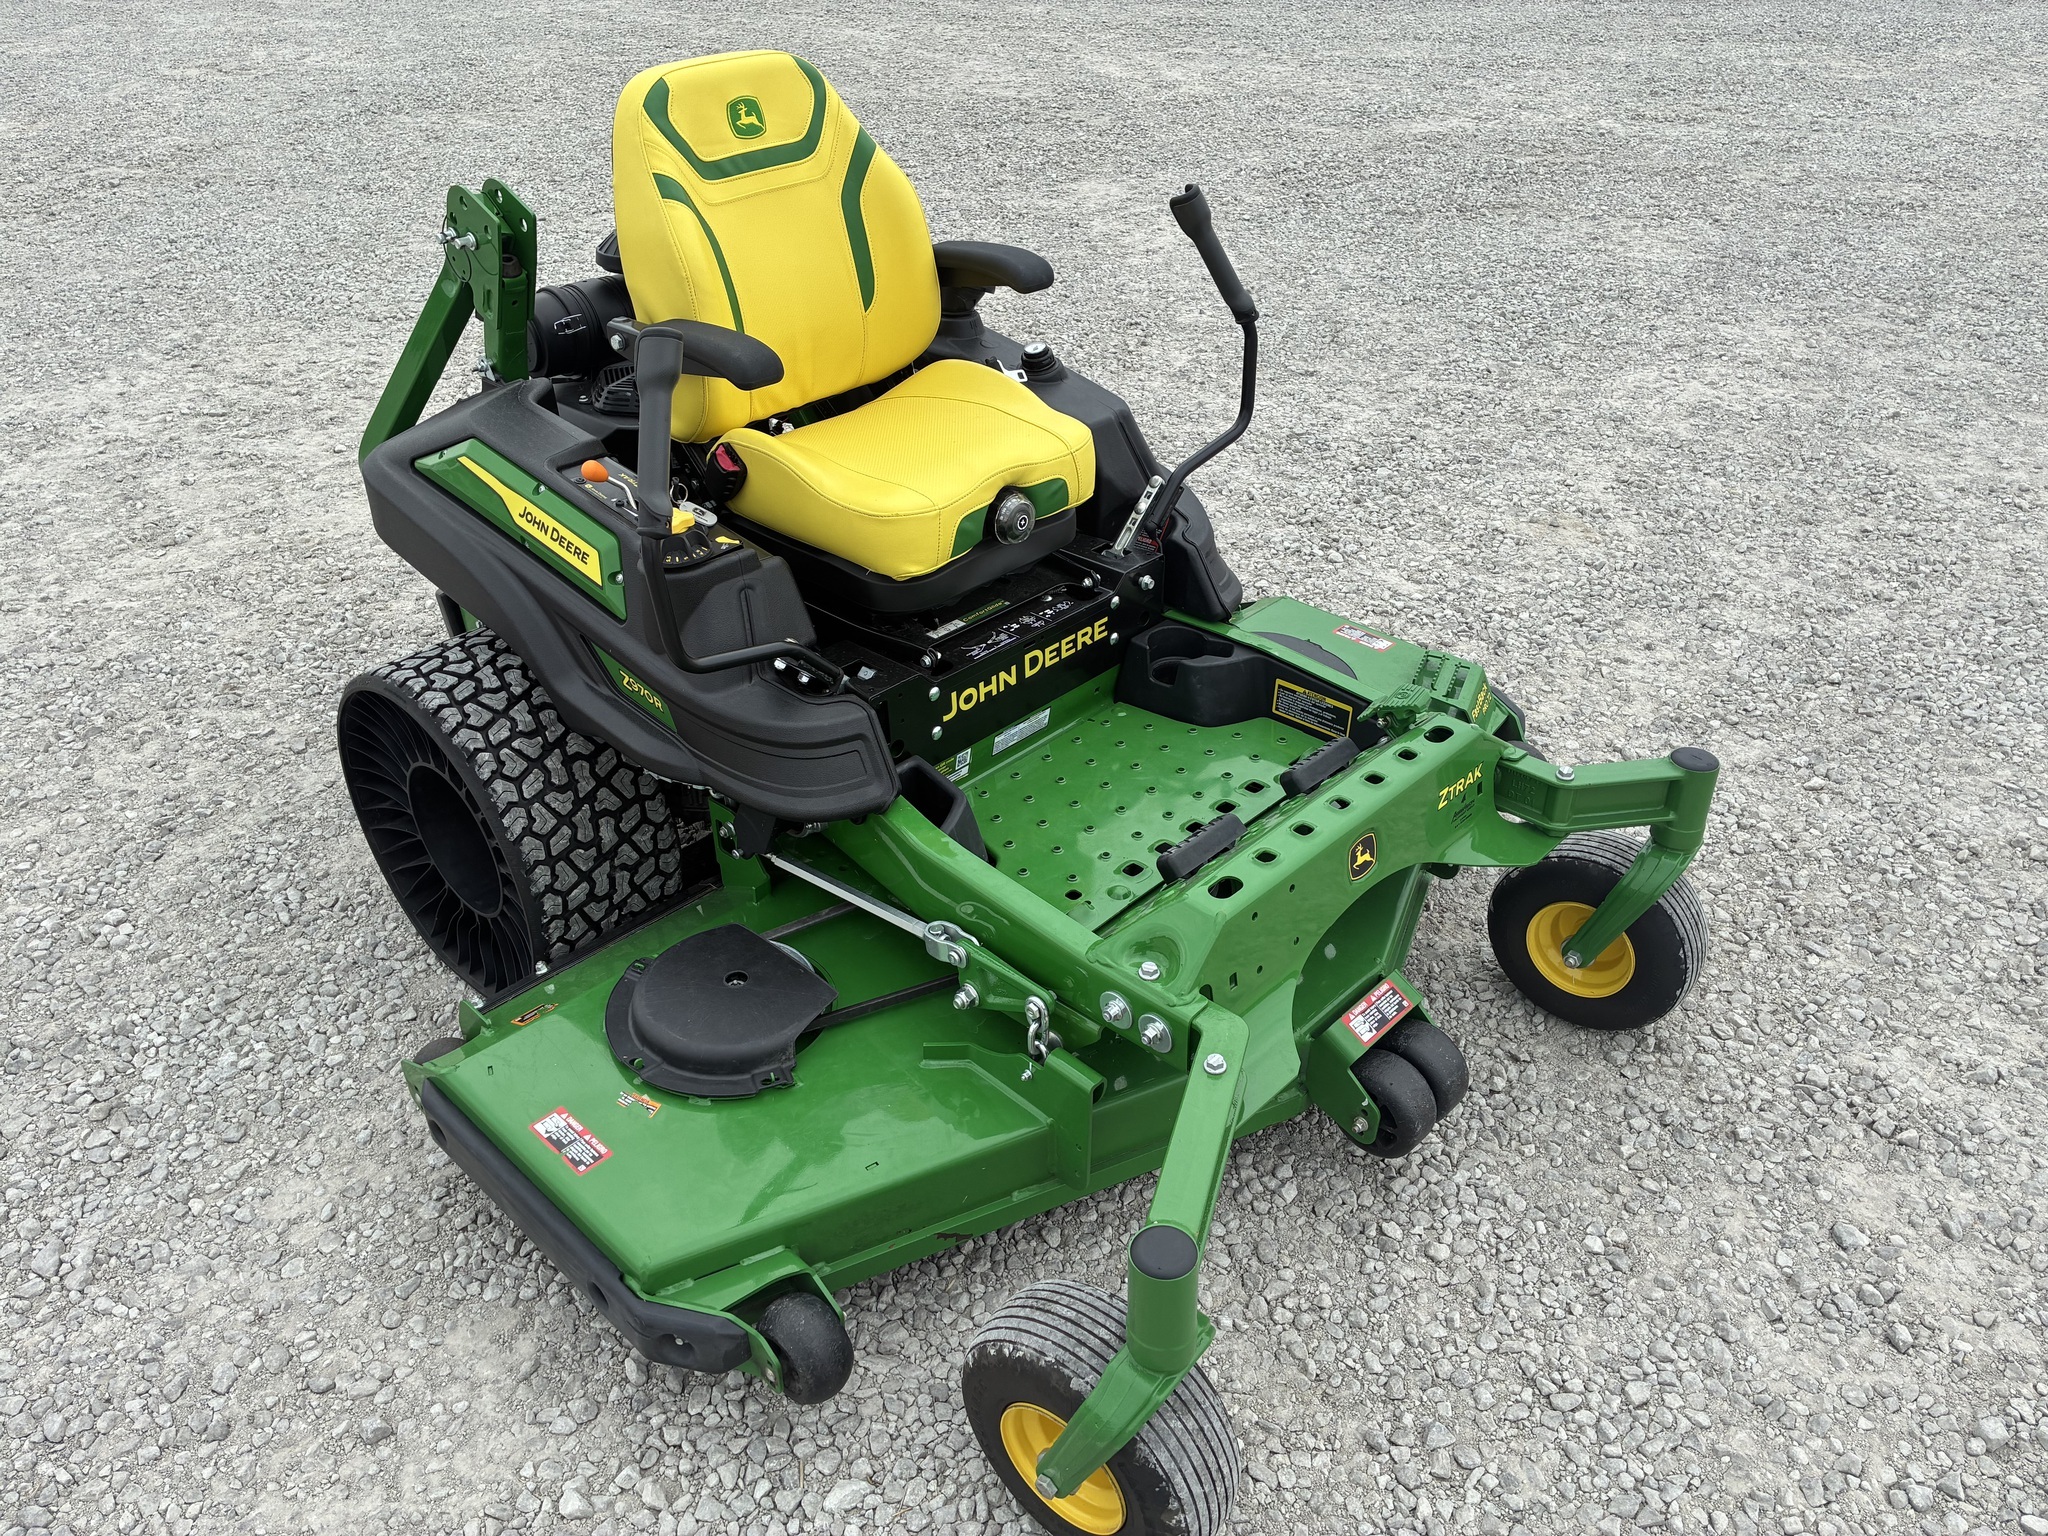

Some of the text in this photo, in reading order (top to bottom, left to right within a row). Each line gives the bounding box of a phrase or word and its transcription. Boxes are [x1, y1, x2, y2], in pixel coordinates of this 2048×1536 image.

[518, 506, 590, 565] JOHN DEERE
[619, 669, 664, 713] Z970R
[943, 616, 1108, 722] JOHN DEERE
[1438, 761, 1485, 810] ZTRAK
